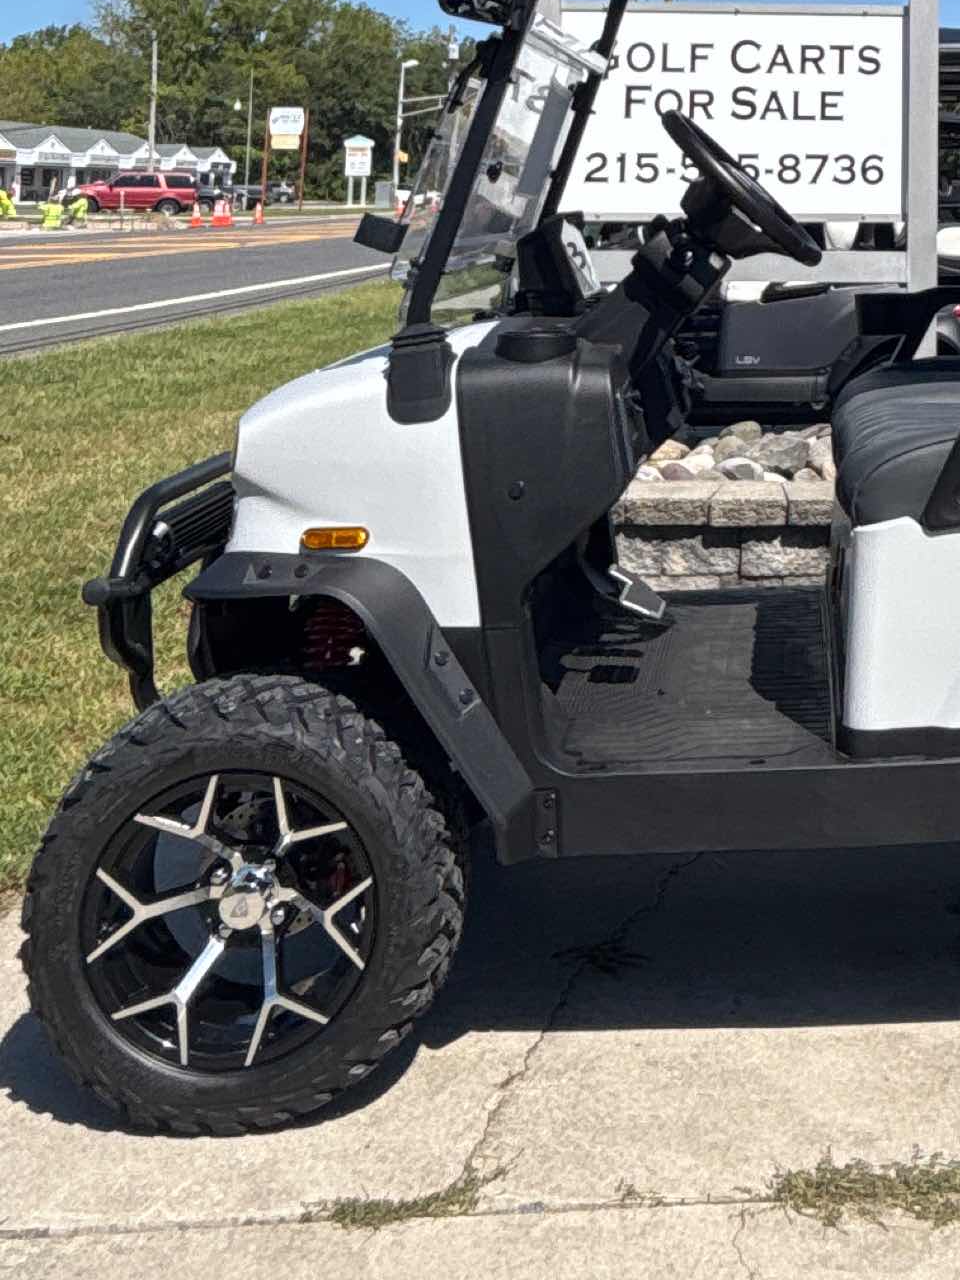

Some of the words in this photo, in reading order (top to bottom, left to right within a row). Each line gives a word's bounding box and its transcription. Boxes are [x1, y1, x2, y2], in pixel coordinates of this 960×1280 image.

[731, 39, 882, 75] CARTS
[624, 84, 715, 120] FOR
[731, 86, 844, 121] SALE
[584, 152, 885, 185] 215-55-8736
